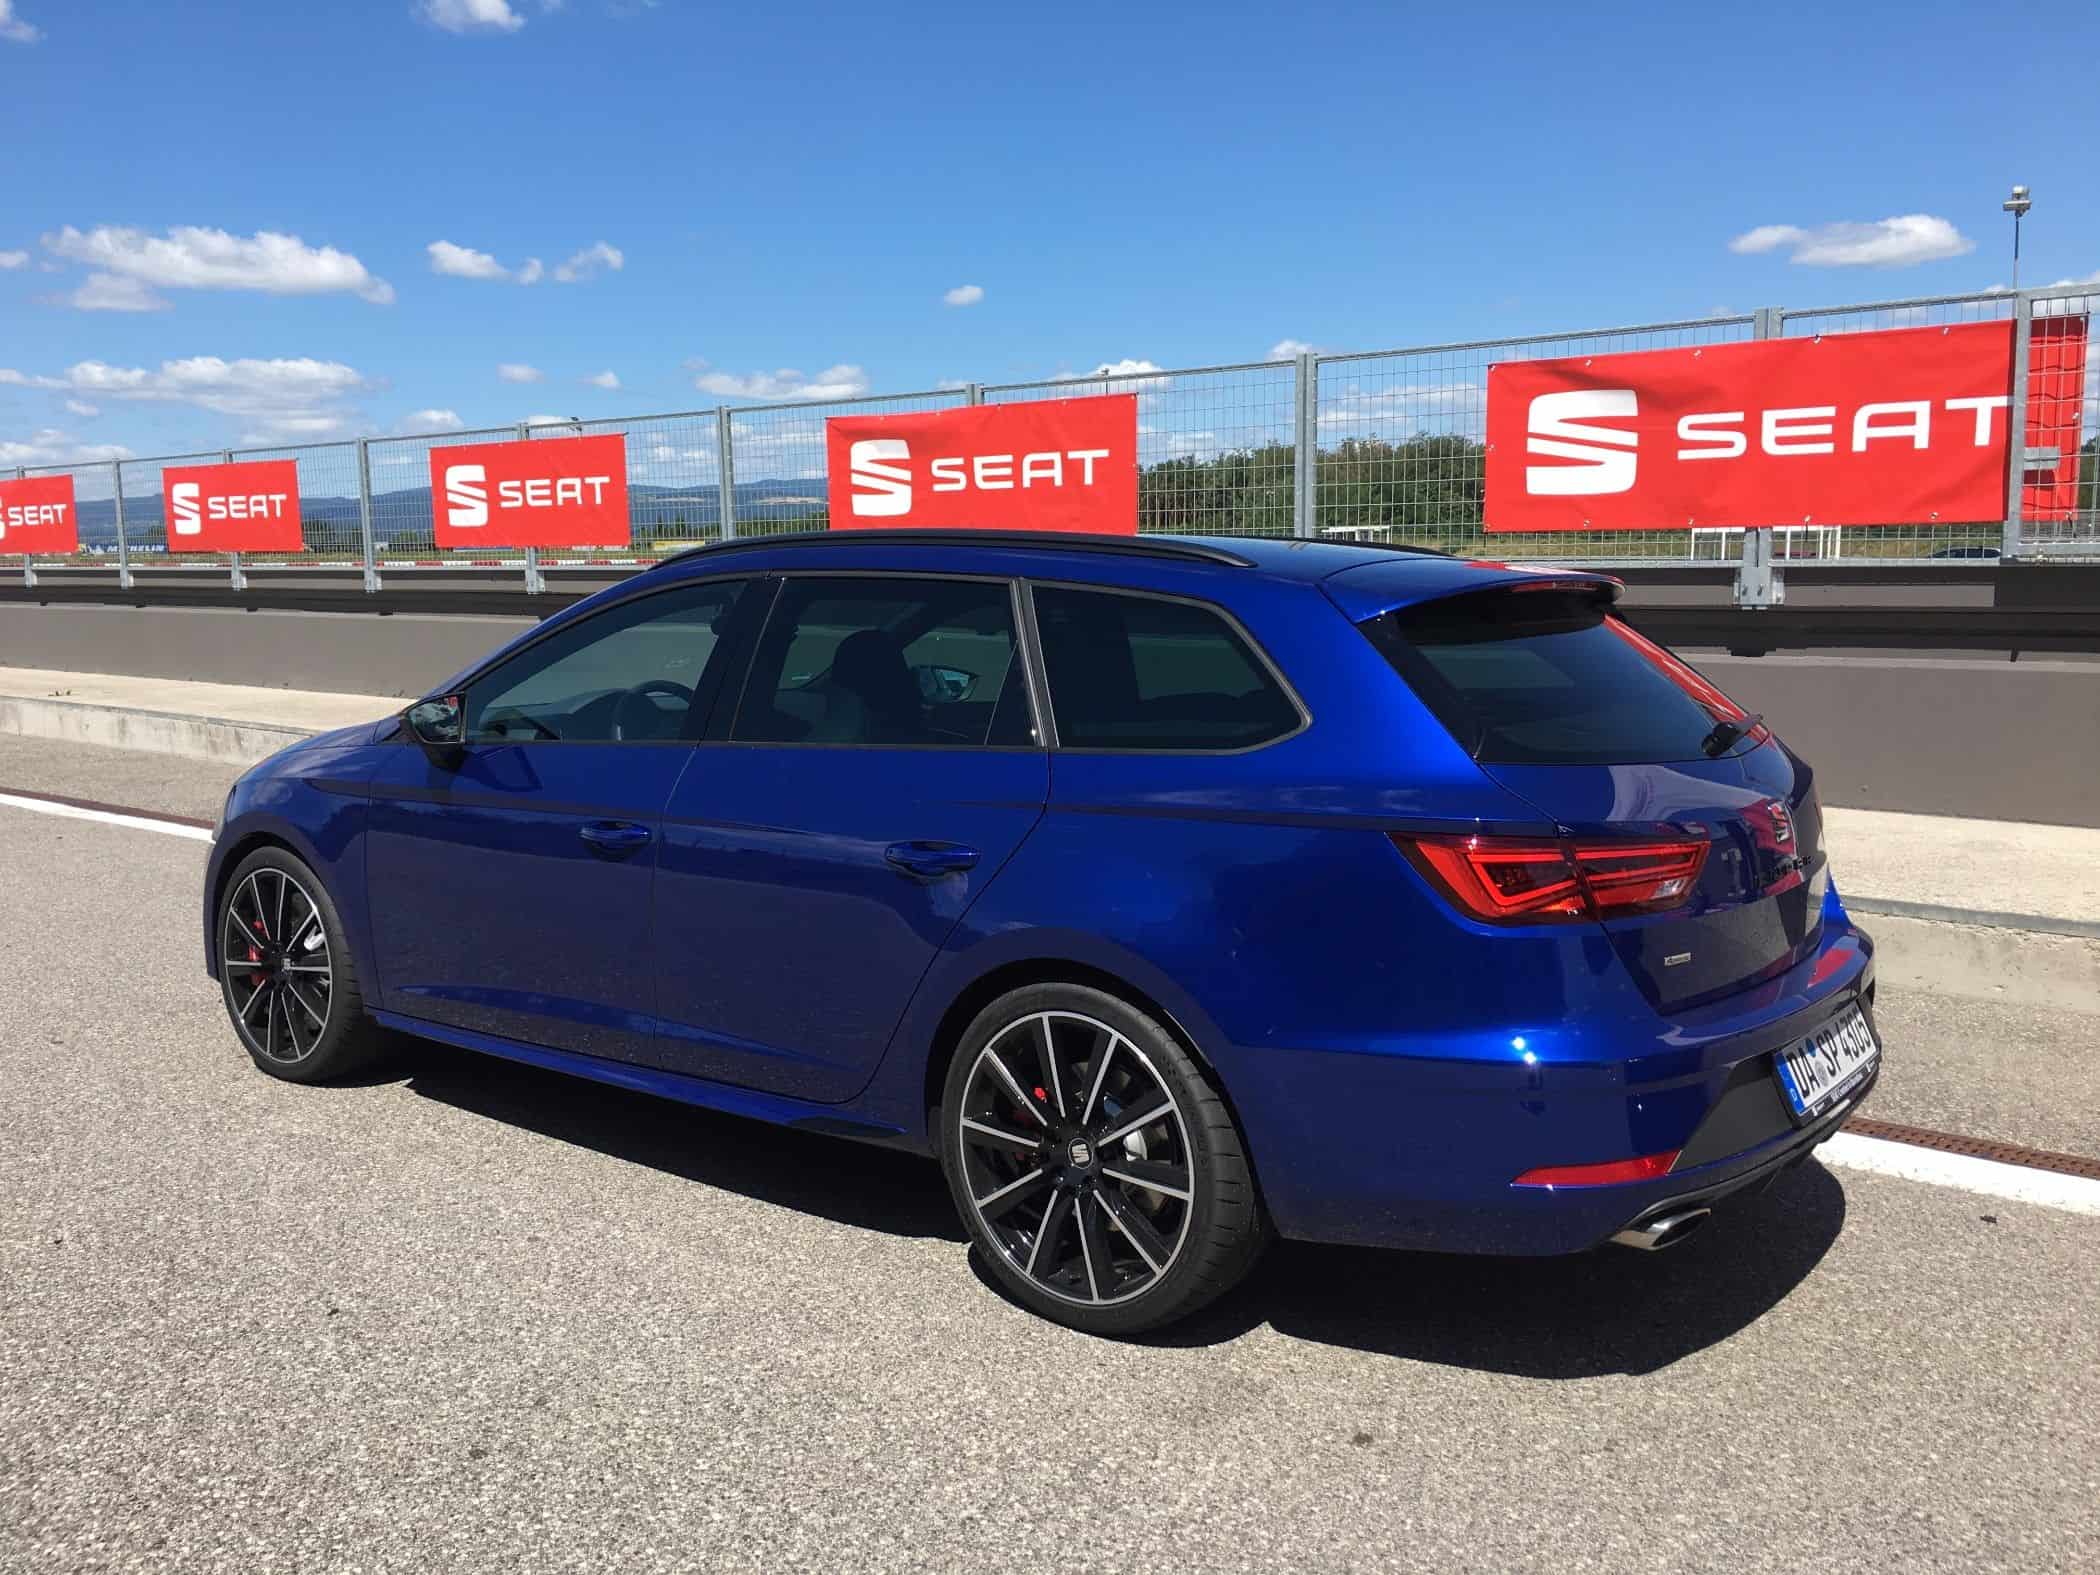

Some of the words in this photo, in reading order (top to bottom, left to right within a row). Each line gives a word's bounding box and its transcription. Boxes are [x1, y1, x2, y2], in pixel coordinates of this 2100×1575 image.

[1676, 395, 2013, 461] SEAT
[931, 449, 1110, 492] SEAT
[207, 493, 287, 520] SEAT
[498, 473, 610, 508] SEAT
[7, 503, 67, 527] SEAT
[1786, 1046, 1821, 1098] DA
[1816, 1029, 1841, 1077] SP
